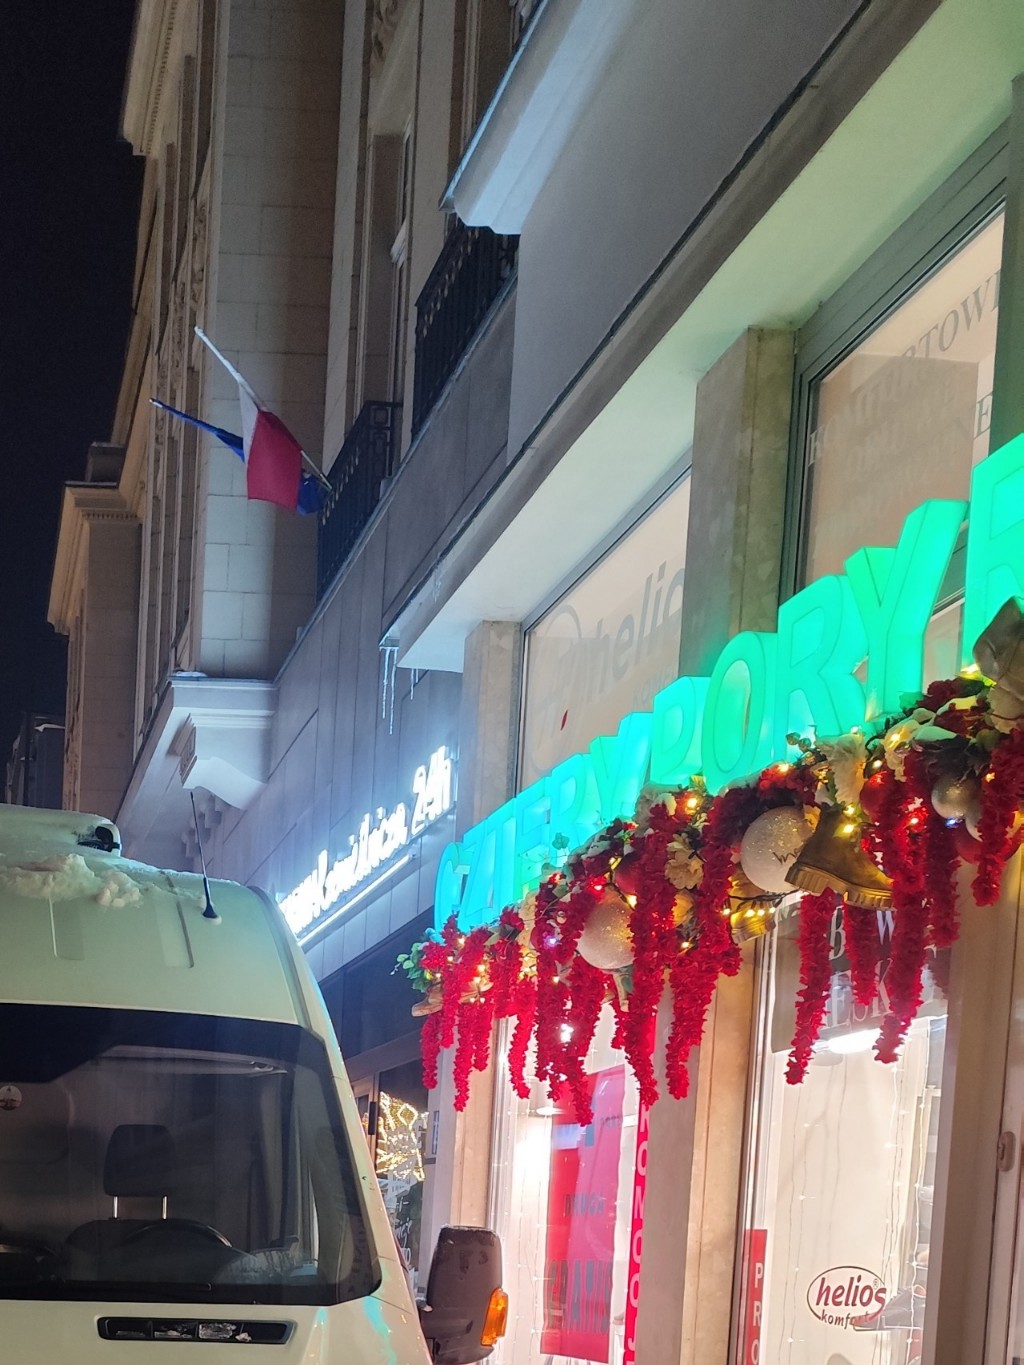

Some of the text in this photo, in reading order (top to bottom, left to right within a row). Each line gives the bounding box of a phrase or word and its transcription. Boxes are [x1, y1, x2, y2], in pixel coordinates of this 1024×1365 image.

[435, 712, 651, 934] CZTERY
[651, 500, 971, 795] PORY
[816, 1274, 887, 1307] helios
